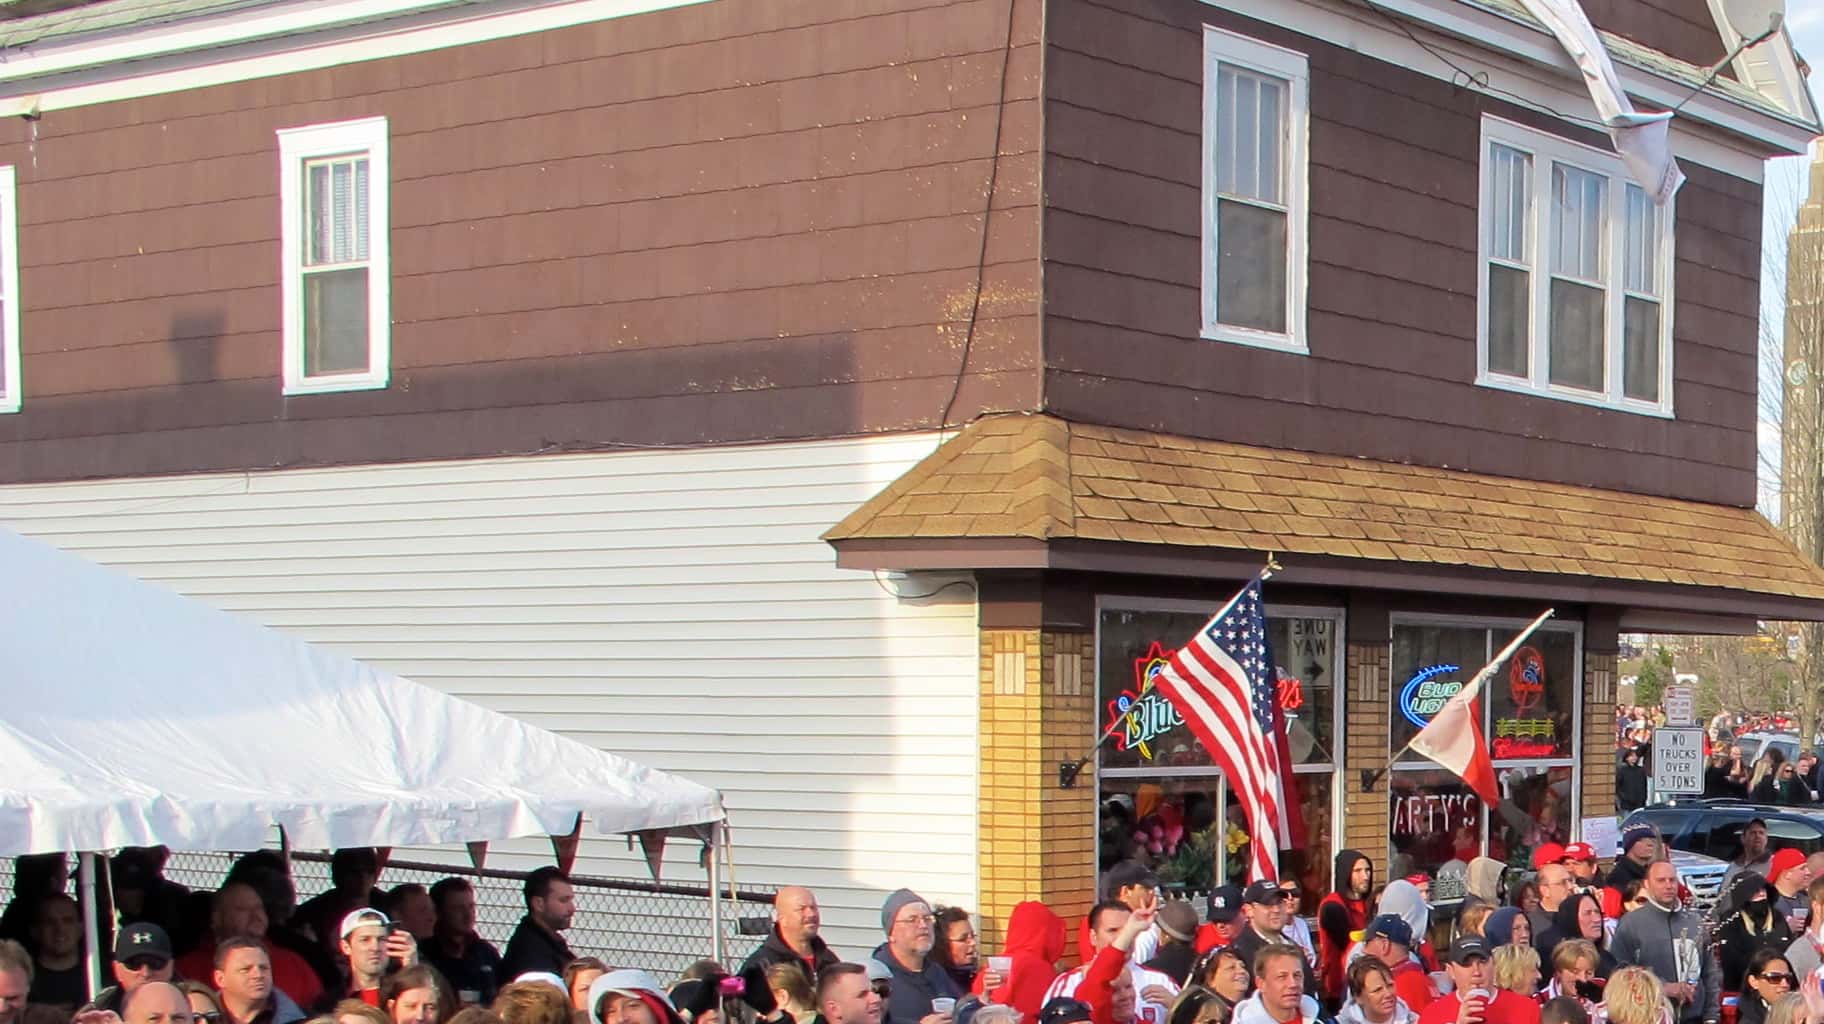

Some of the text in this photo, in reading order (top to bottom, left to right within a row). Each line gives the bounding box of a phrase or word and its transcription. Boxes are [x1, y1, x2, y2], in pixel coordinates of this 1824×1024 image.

[1418, 681, 1463, 698] BUD
[1409, 697, 1448, 714] LIG
[1671, 734, 1686, 746] NO
[1660, 748, 1697, 760] TRUCKS
[1665, 762, 1690, 773] OVER
[1660, 775, 1697, 789] 5 TONS
[1392, 794, 1476, 834] ARTY'S
